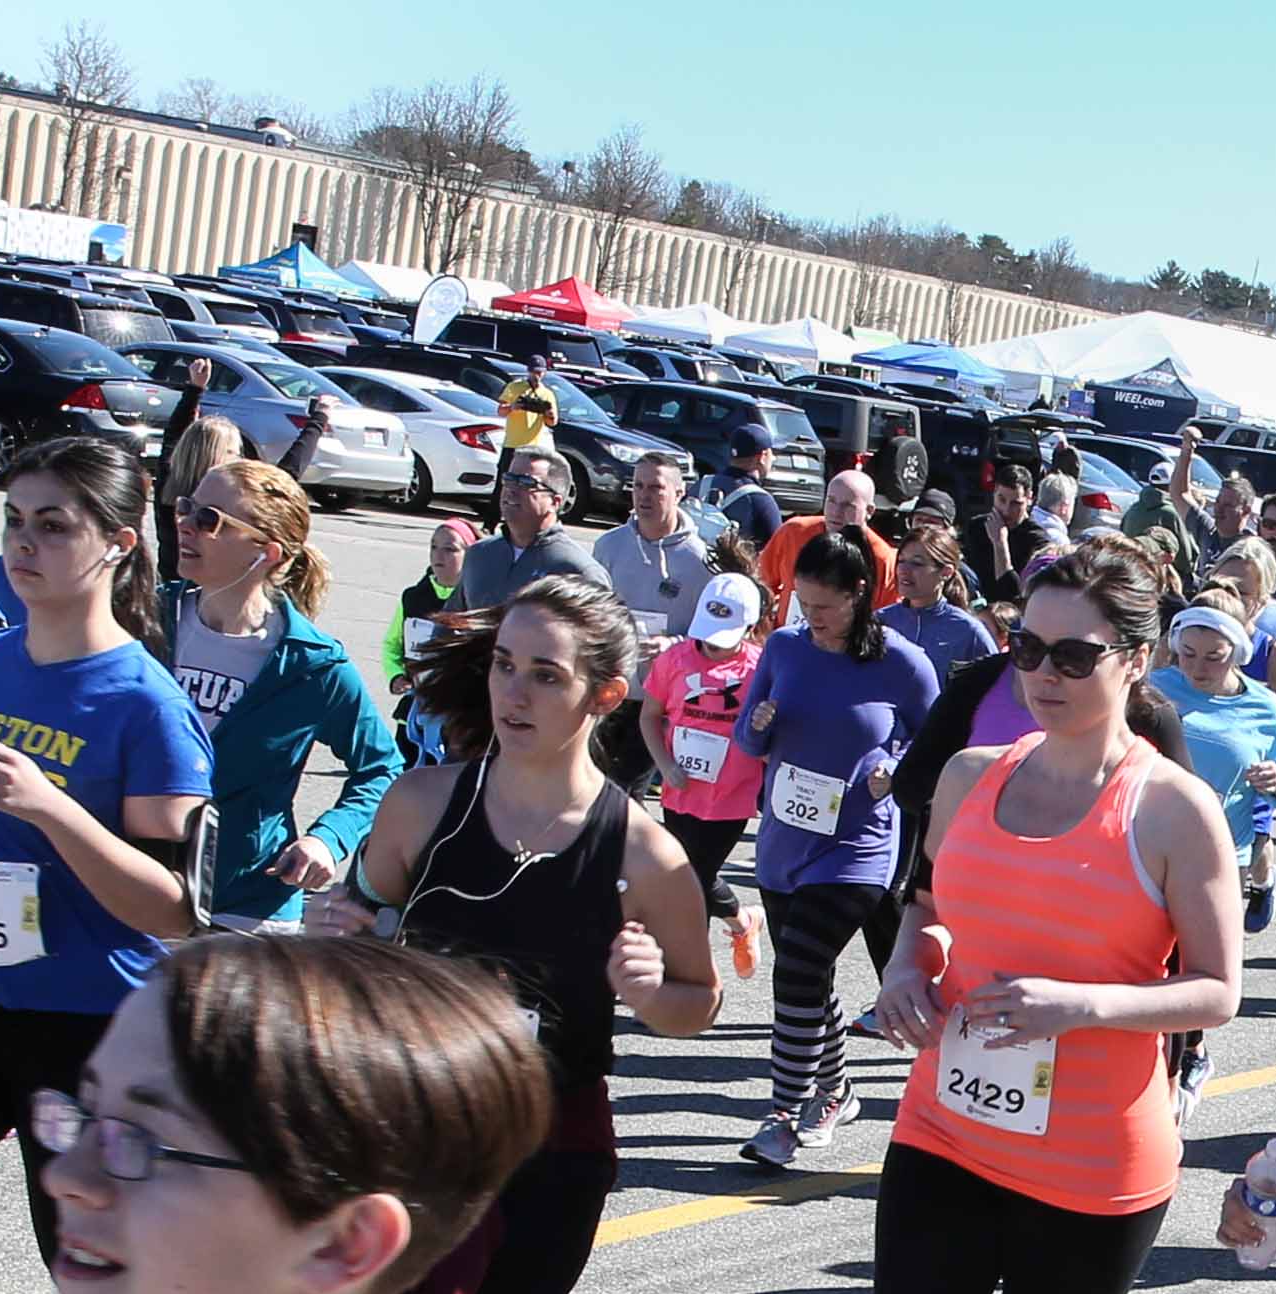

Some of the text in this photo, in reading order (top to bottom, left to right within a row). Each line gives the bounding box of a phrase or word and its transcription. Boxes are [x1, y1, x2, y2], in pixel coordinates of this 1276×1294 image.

[1114, 389, 1166, 409] WEEI.com
[679, 754, 712, 773] 2851
[785, 799, 819, 822] 202
[948, 1068, 1025, 1114] 2429
